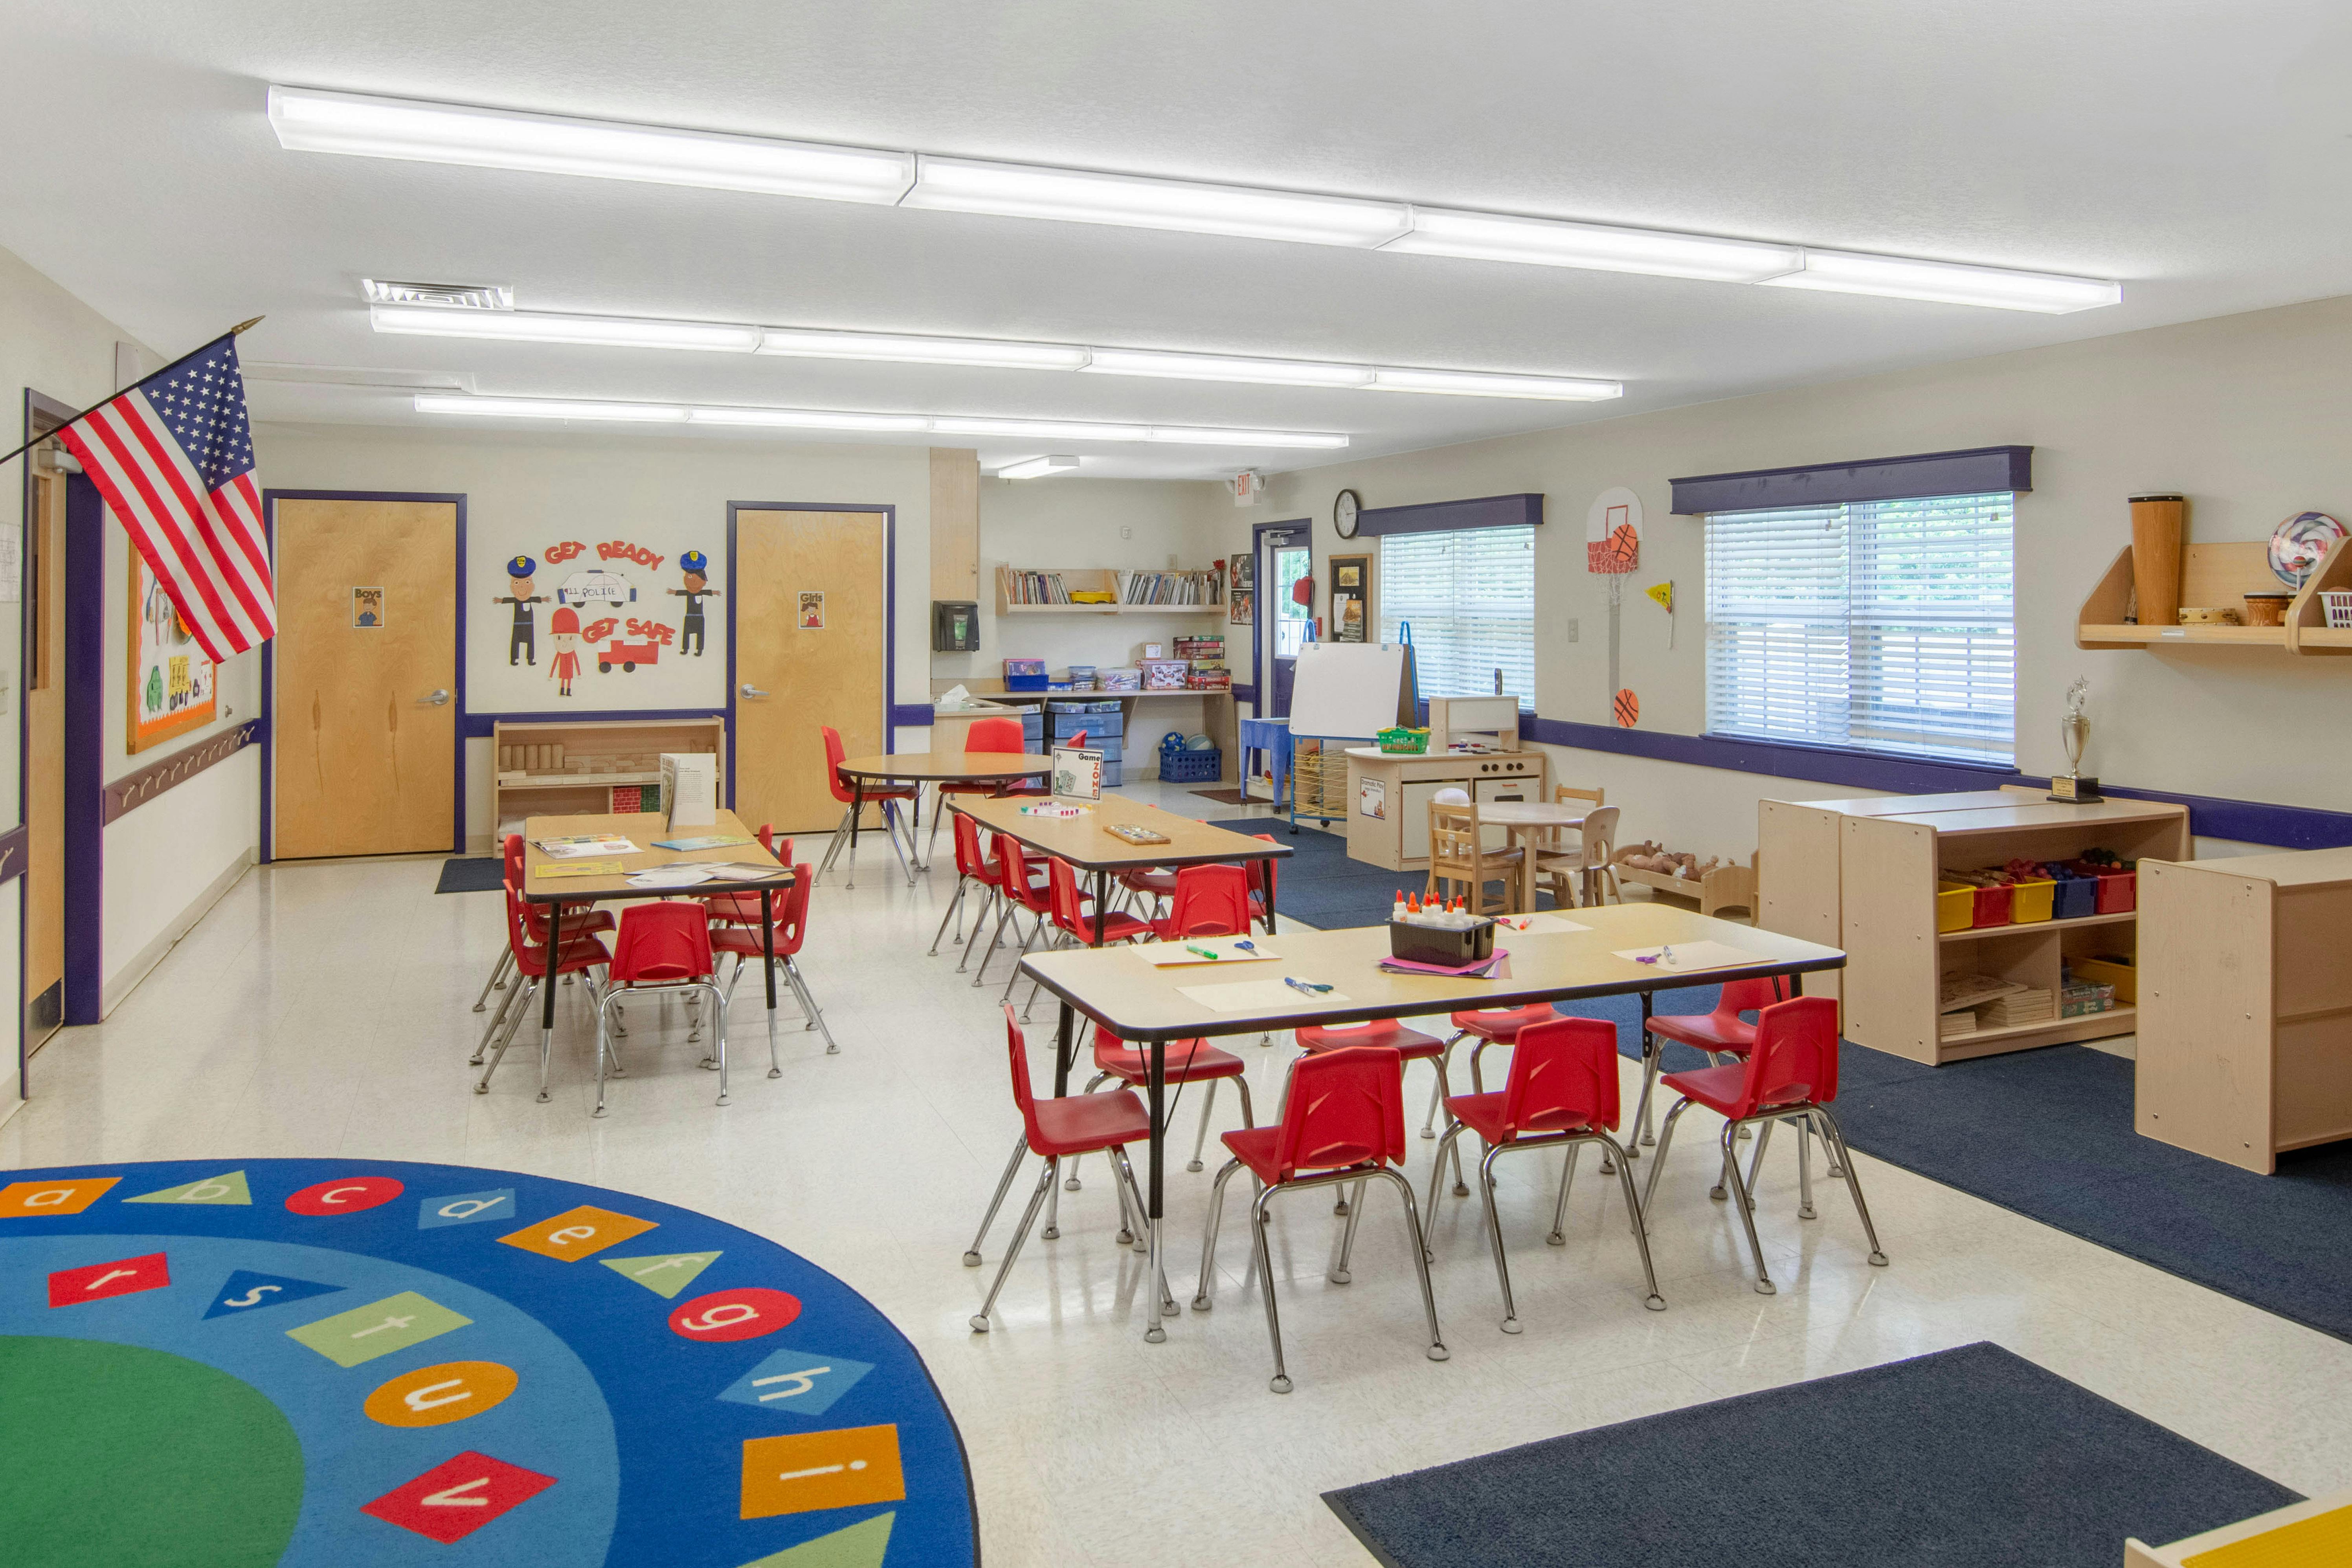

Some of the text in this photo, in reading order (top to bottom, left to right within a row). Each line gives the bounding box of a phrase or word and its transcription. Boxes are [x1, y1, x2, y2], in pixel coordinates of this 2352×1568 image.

[1238, 474, 1250, 496] EXIT
[545, 540, 664, 571] GET READY
[355, 589, 381, 600] Boys
[582, 587, 616, 597] POLICE
[800, 593, 823, 602] Girls
[582, 617, 676, 646] GET SAFE
[1078, 753, 1100, 761] Game
[1361, 779, 1376, 787] Dramatic
[24, 1178, 867, 1480] a b c d e f g h i
[85, 1270, 489, 1506] r s t u v
